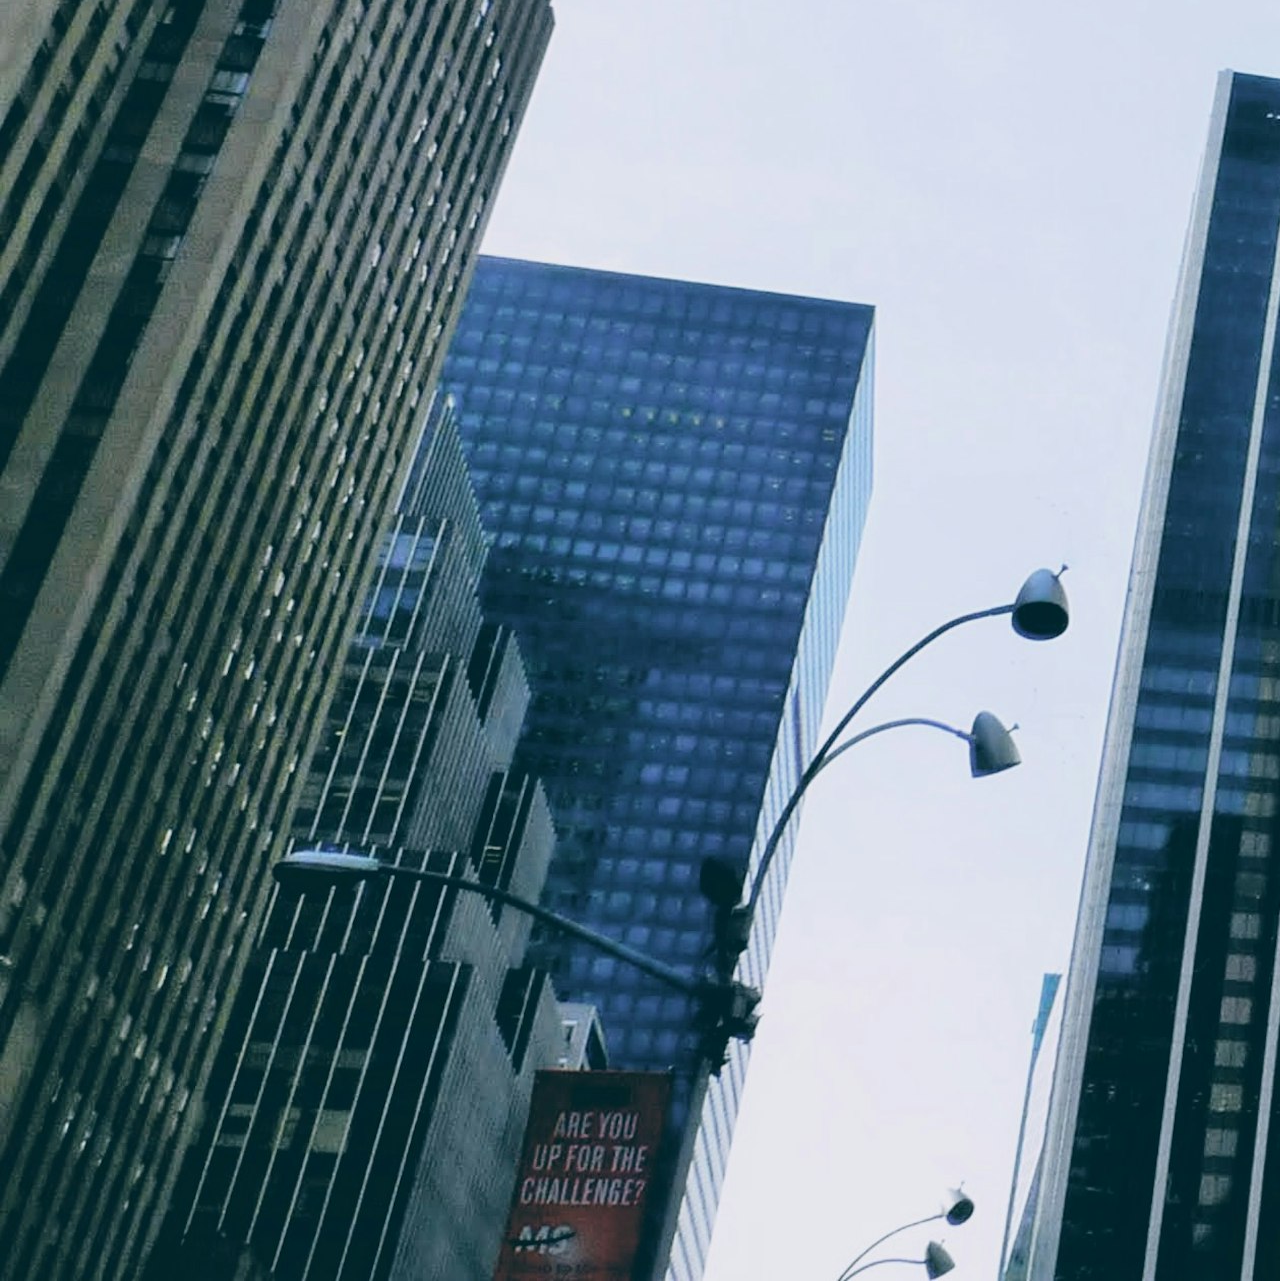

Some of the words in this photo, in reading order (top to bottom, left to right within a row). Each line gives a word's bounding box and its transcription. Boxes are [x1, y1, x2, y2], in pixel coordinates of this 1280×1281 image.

[553, 1112, 595, 1139] ARE
[598, 1112, 639, 1139] YOU
[532, 1144, 562, 1171] UP
[565, 1144, 606, 1172] FOR
[612, 1145, 648, 1173] THE
[520, 1177, 646, 1206] CHALLENGE?
